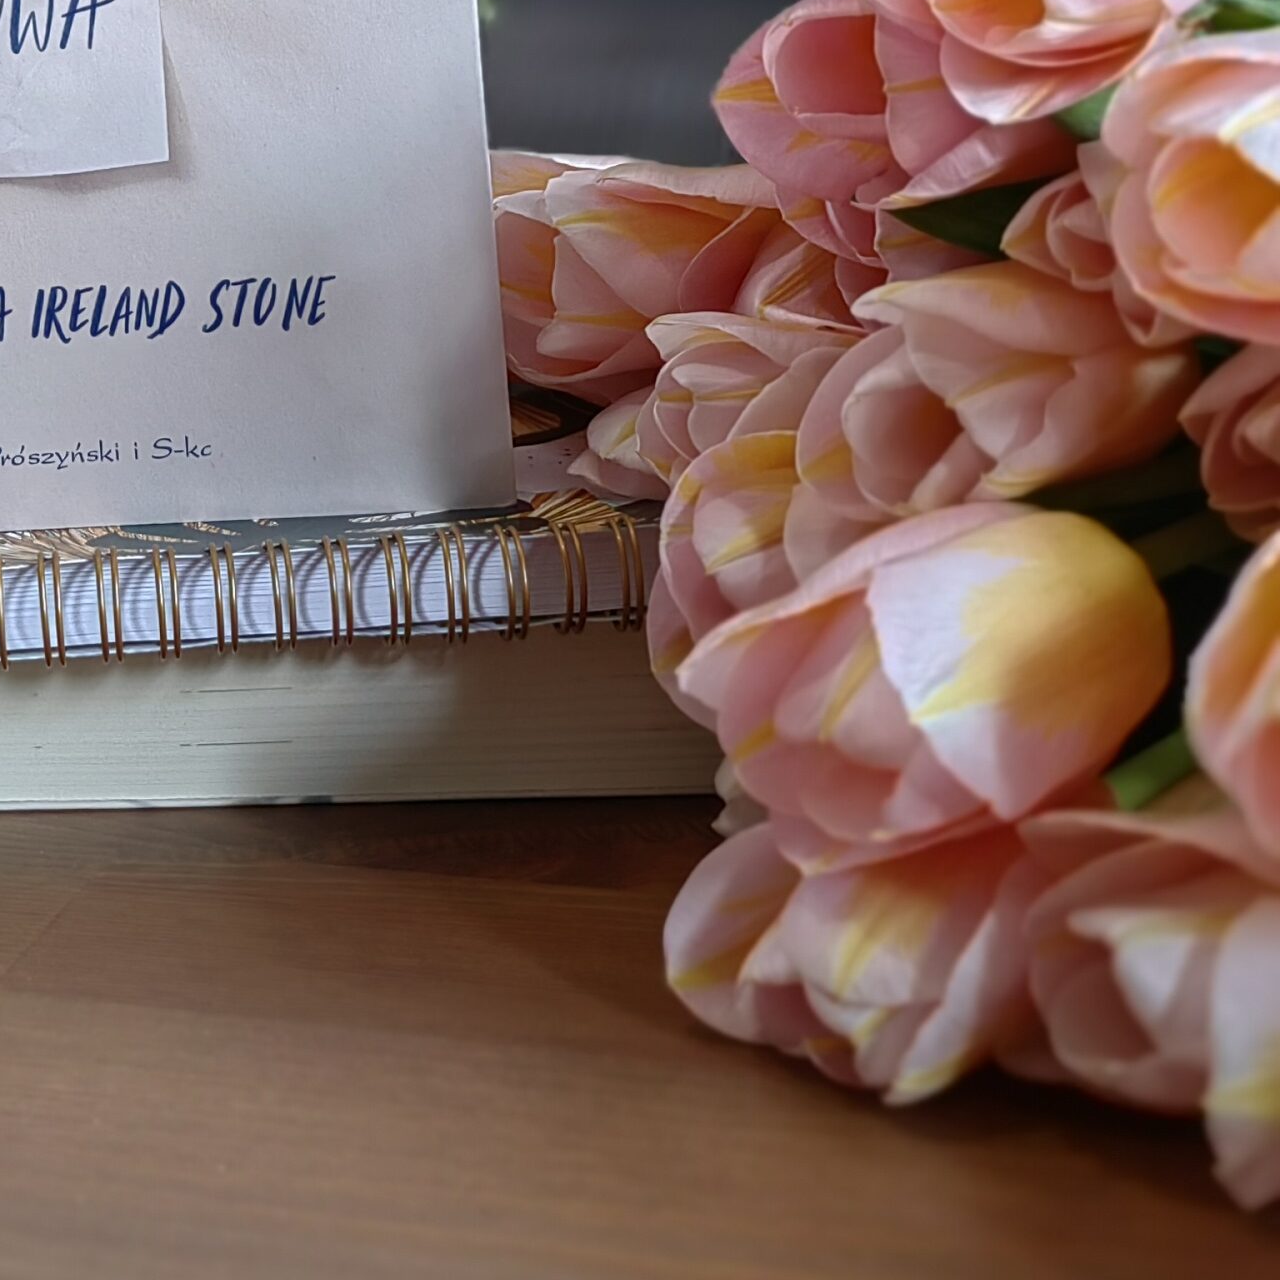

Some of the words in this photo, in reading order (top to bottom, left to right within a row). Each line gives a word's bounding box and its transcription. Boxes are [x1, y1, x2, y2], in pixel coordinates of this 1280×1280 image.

[32, 280, 186, 344] IRELAND
[202, 275, 337, 334] STONE
[133, 441, 139, 460] i
